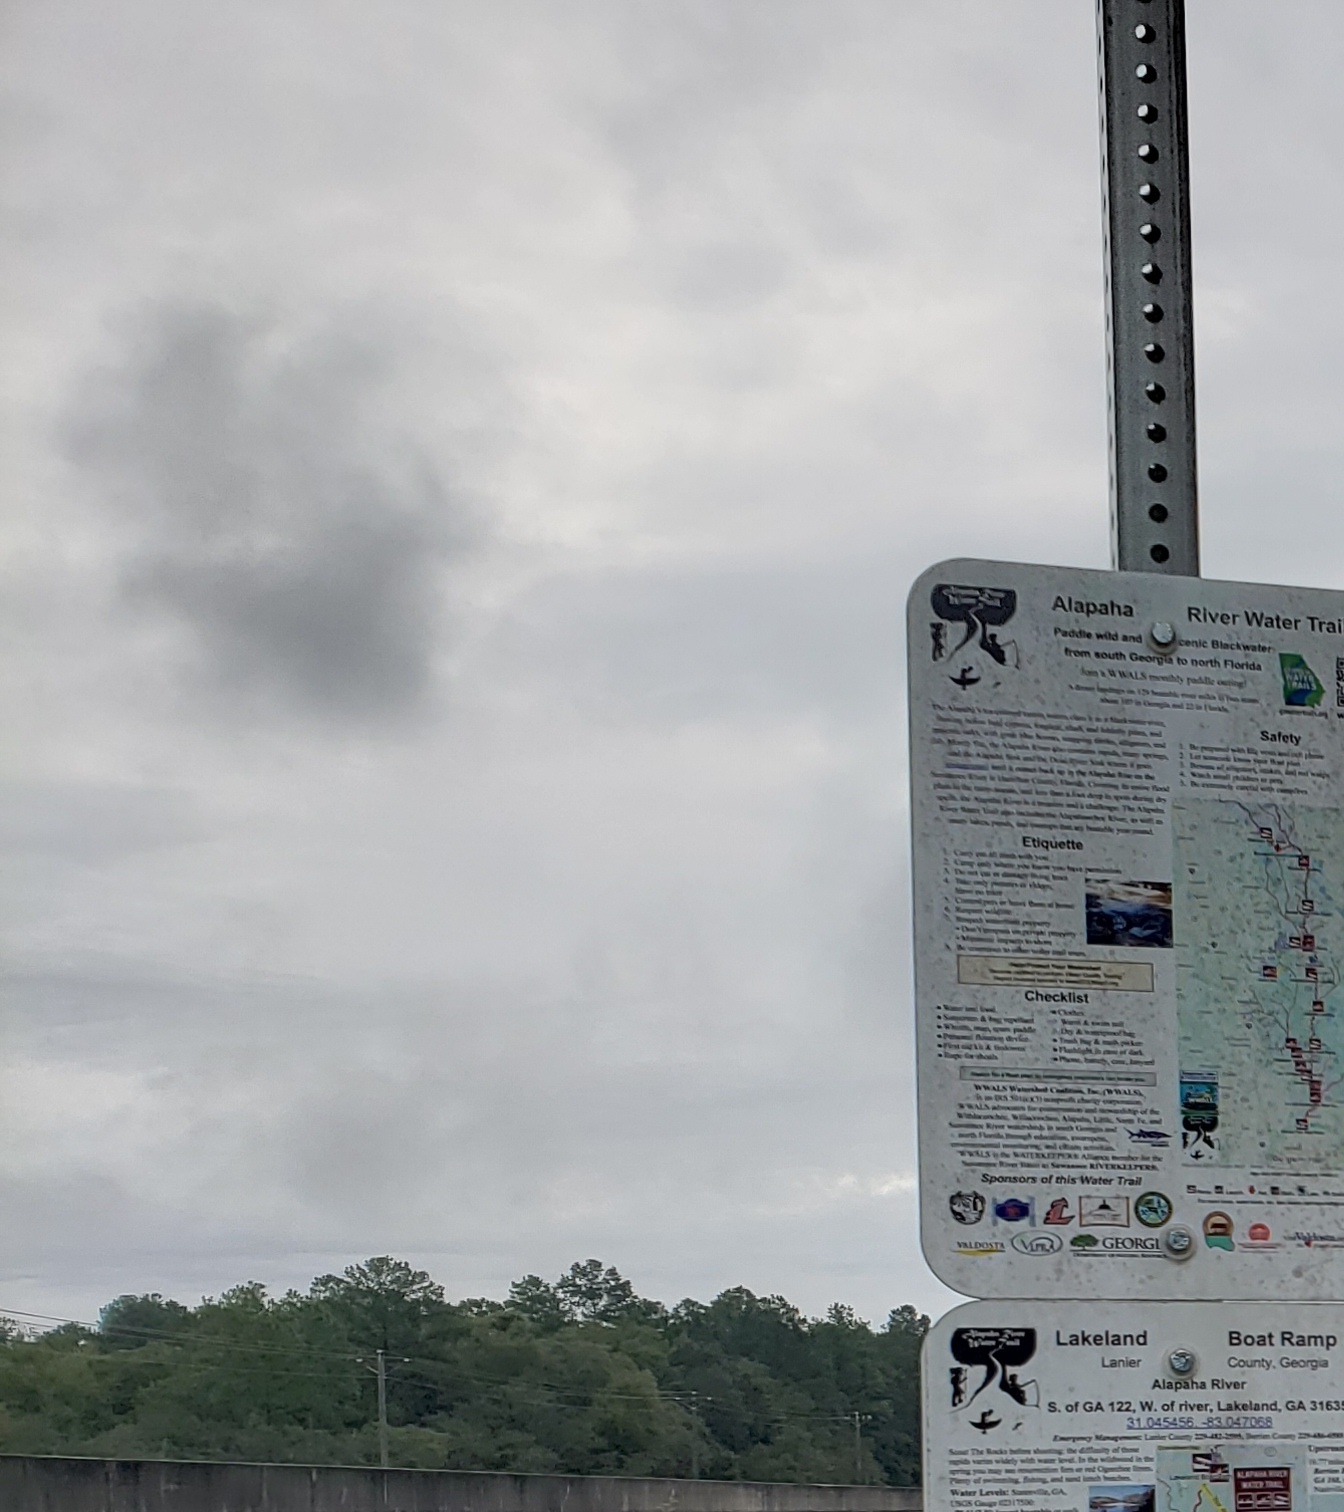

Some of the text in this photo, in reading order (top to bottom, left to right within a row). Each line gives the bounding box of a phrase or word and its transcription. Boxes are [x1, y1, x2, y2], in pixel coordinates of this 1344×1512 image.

[1051, 596, 1134, 617] Alapaha
[1187, 607, 1240, 625] River
[1244, 610, 1301, 630] Water
[1054, 627, 1271, 654] Paddle wild and cenic Blackwater
[1064, 647, 1262, 672] from south Georgia to north Florida
[1260, 730, 1301, 746] Safety
[1022, 836, 1083, 851] Etiquette
[1024, 989, 1089, 1004] Checklist
[981, 1174, 1142, 1186] Sponsors of this Water Trail
[957, 1240, 1005, 1249] VALDOSTA
[1101, 1236, 1160, 1250] GEORGI
[1056, 1330, 1337, 1350] Lakeland Boat Ramp
[1101, 1356, 1329, 1371] Lanier County, Georgia
[1152, 1378, 1247, 1392] Alapaha River
[1047, 1401, 1061, 1413] S.
[1065, 1401, 1079, 1412] of
[1082, 1401, 1105, 1412] GA
[1108, 1401, 1136, 1414] 122,
[1139, 1400, 1157, 1412] W.
[1161, 1400, 1175, 1412] of
[1178, 1400, 1213, 1413] river,
[1217, 1400, 1282, 1413] Lakeland,
[1285, 1400, 1306, 1411] GA
[950, 1489, 977, 1497] Water
[979, 1488, 1009, 1497] Levels:
